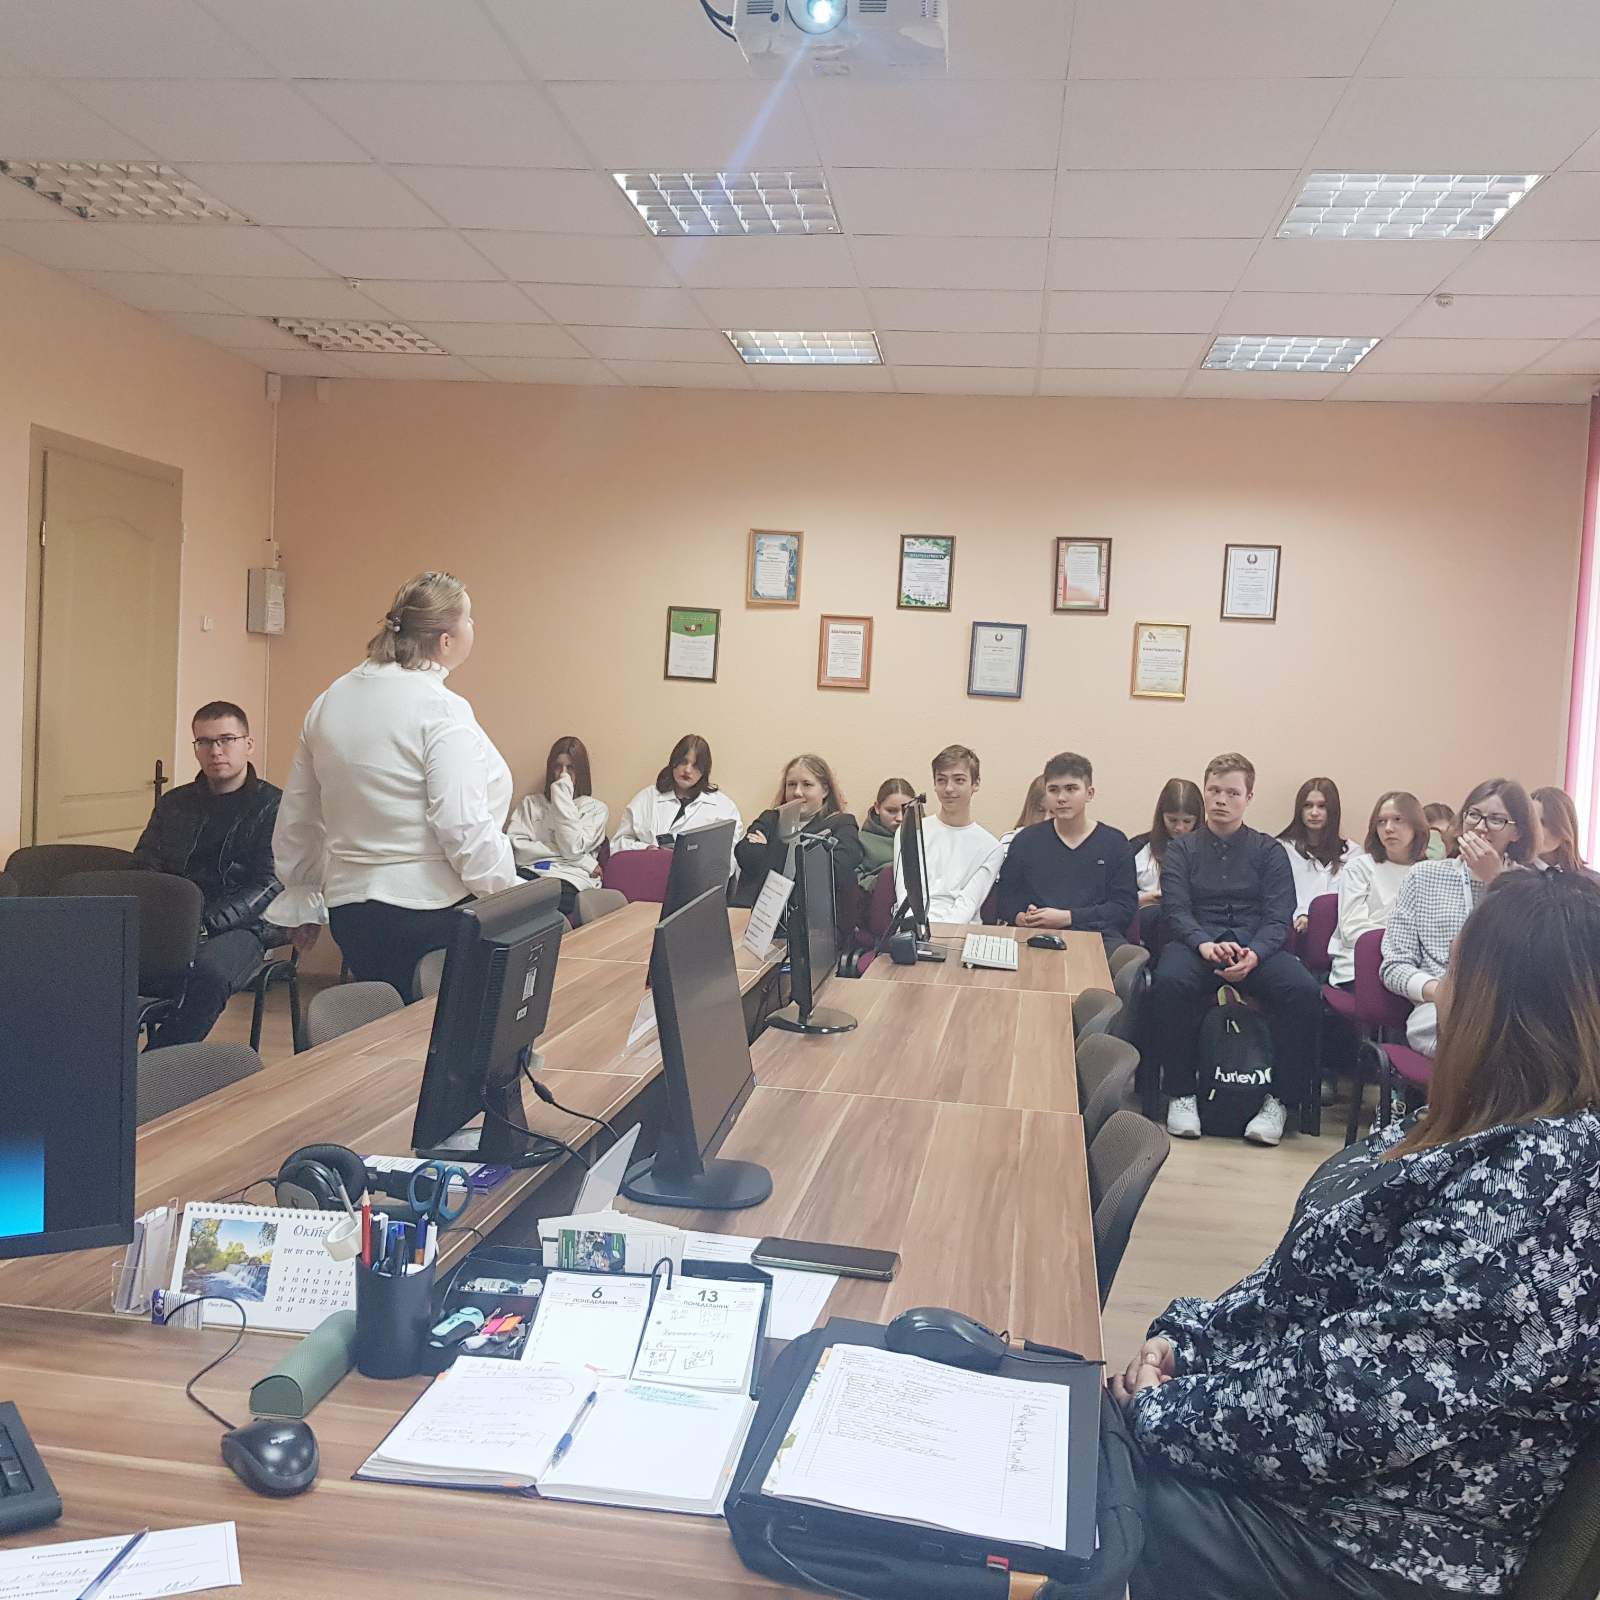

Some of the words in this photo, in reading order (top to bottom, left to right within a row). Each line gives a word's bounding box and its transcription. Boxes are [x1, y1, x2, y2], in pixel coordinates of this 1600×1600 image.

[1215, 1066, 1256, 1085] hurley
[591, 1286, 603, 1299] 6
[697, 1289, 718, 1303] 13
